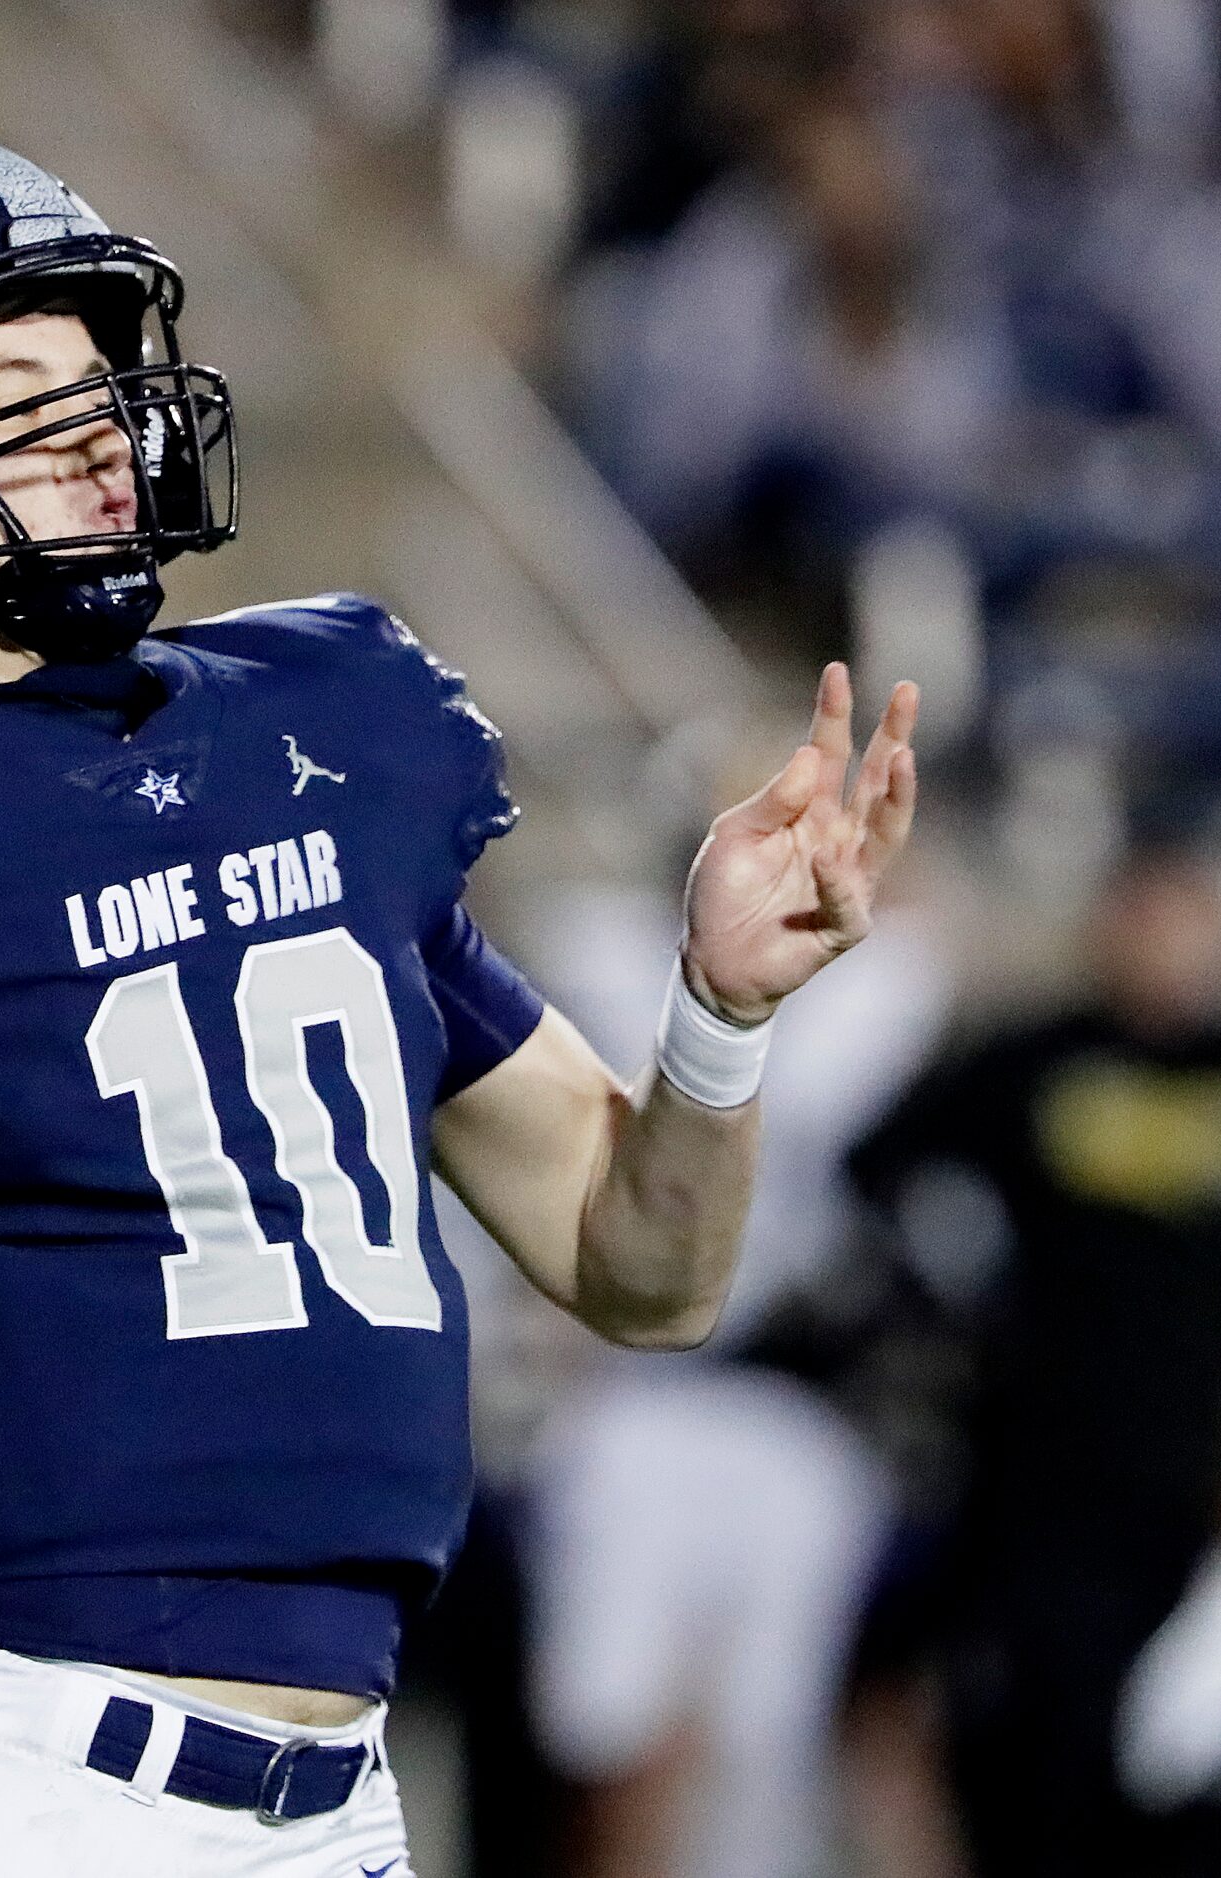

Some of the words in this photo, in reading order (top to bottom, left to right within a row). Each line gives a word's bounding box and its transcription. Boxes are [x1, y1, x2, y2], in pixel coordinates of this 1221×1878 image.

[65, 863, 205, 968] LONE
[218, 830, 342, 927] STAR
[84, 927, 442, 1340] 10
